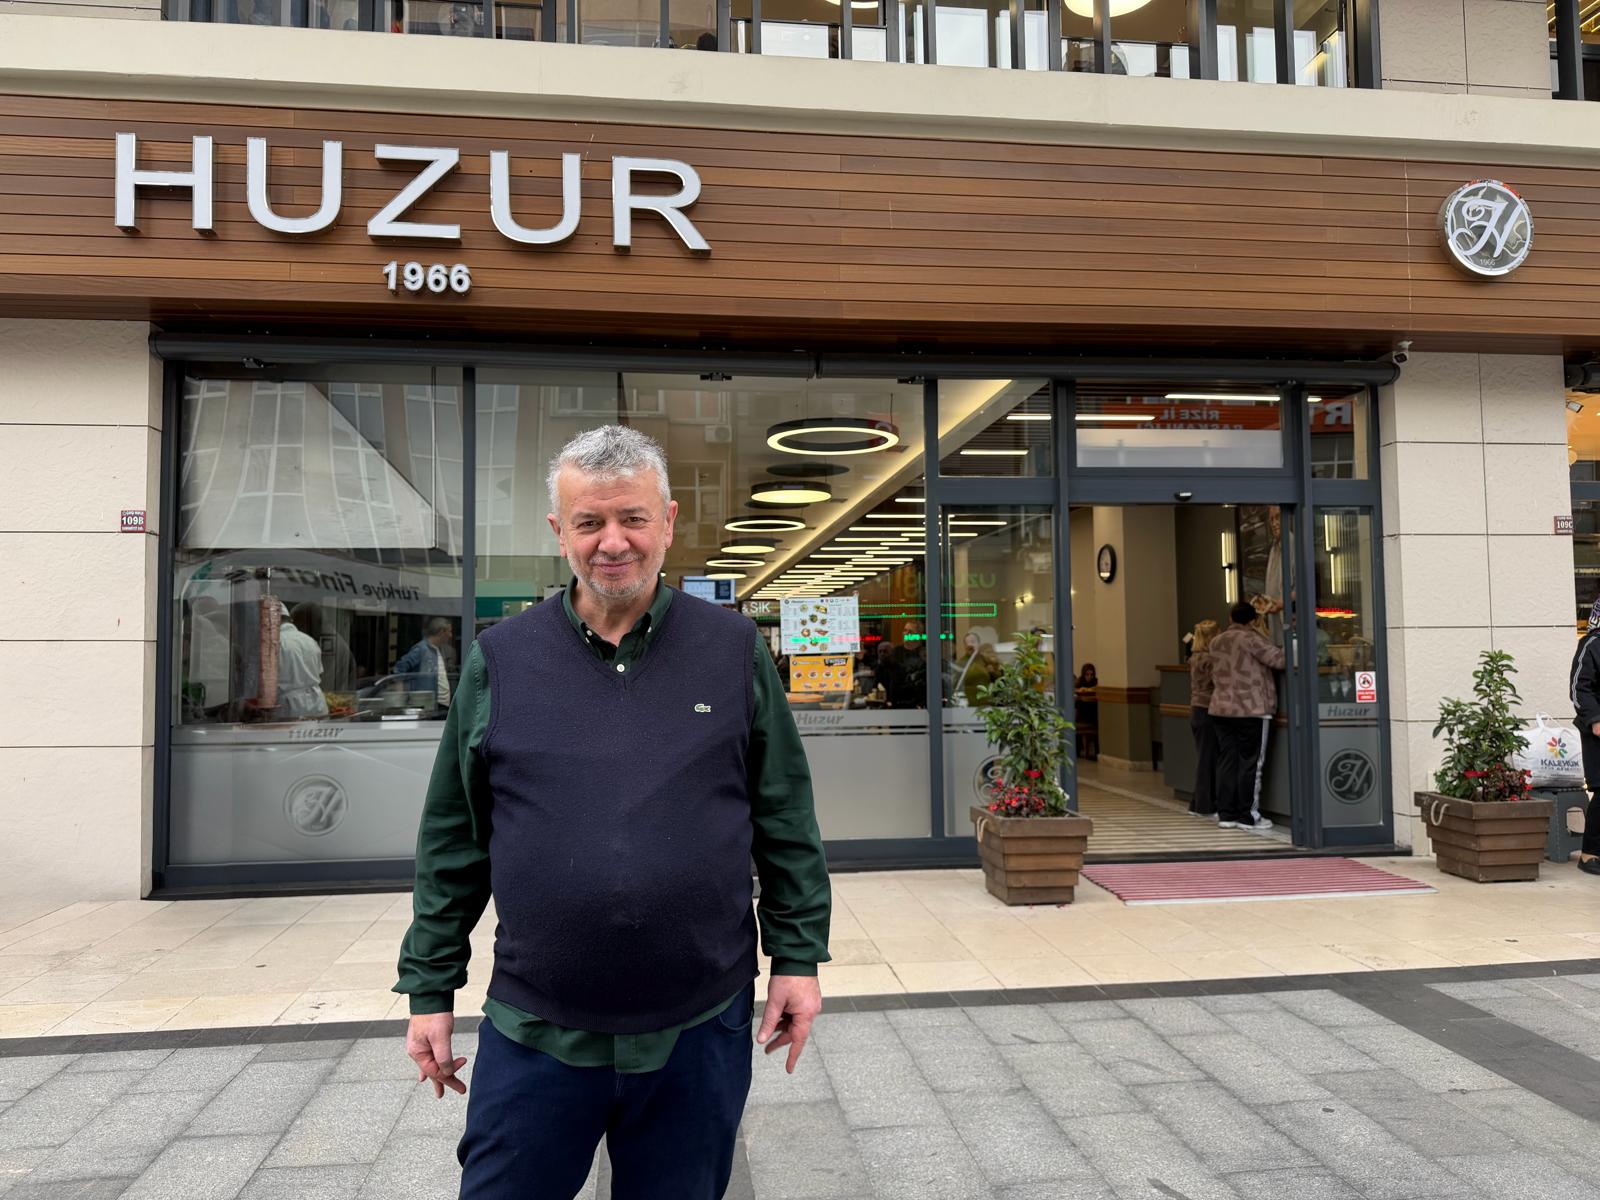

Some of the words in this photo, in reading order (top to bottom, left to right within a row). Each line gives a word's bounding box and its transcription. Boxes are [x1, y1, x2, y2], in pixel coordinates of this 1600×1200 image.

[115, 132, 711, 252] HUZUR
[382, 260, 472, 293] 1966
[121, 515, 144, 526] 109B
[1327, 705, 1371, 717] Huzur
[796, 712, 845, 725] Huzur
